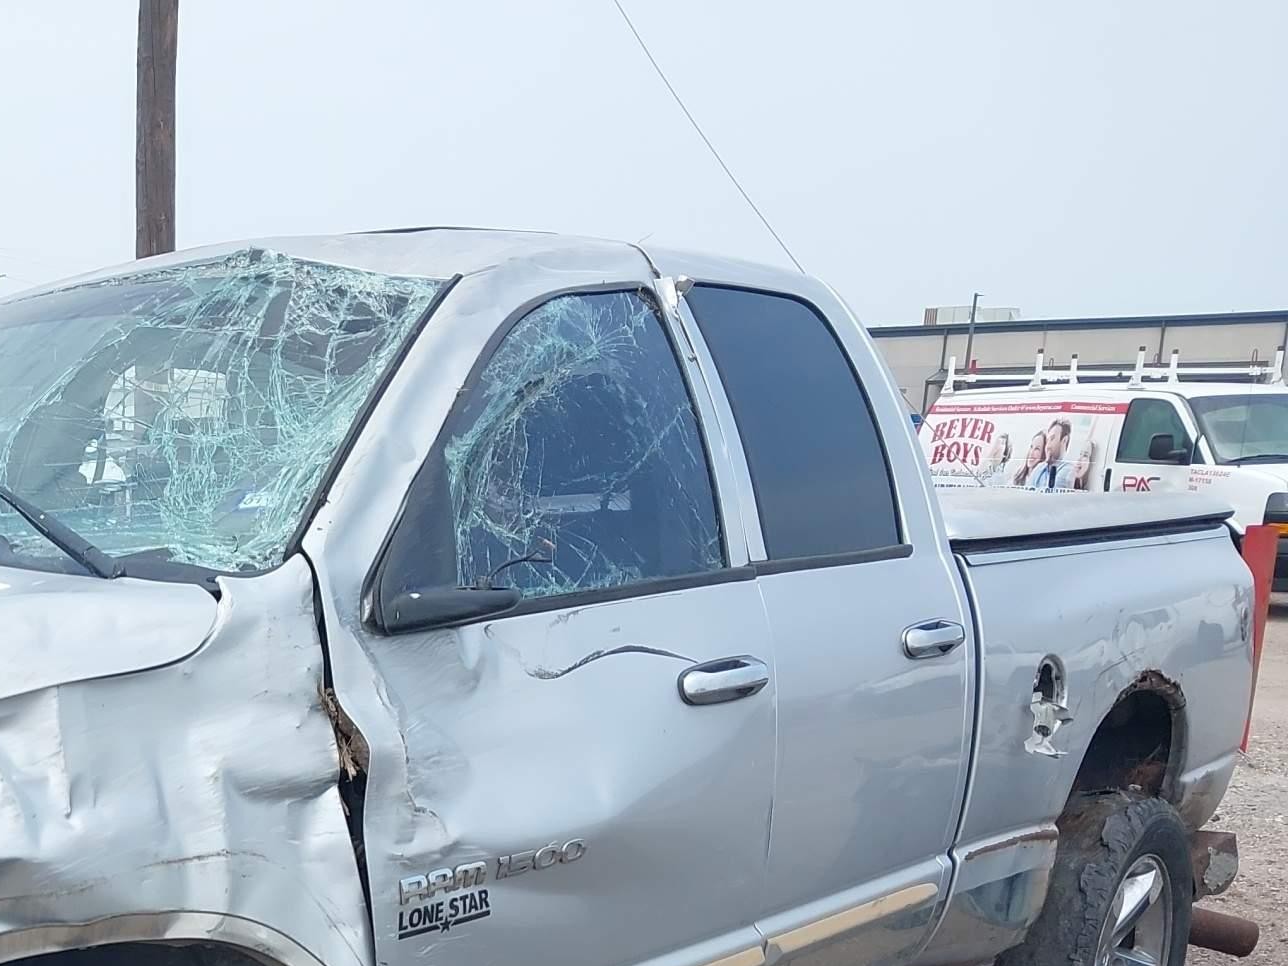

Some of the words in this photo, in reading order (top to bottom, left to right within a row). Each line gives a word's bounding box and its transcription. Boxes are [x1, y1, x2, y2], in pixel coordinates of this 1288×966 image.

[930, 417, 995, 443] BEYER
[930, 441, 982, 467] BOYS
[399, 861, 488, 906] RAM
[398, 901, 444, 932] LONE
[449, 889, 490, 919] STAR
